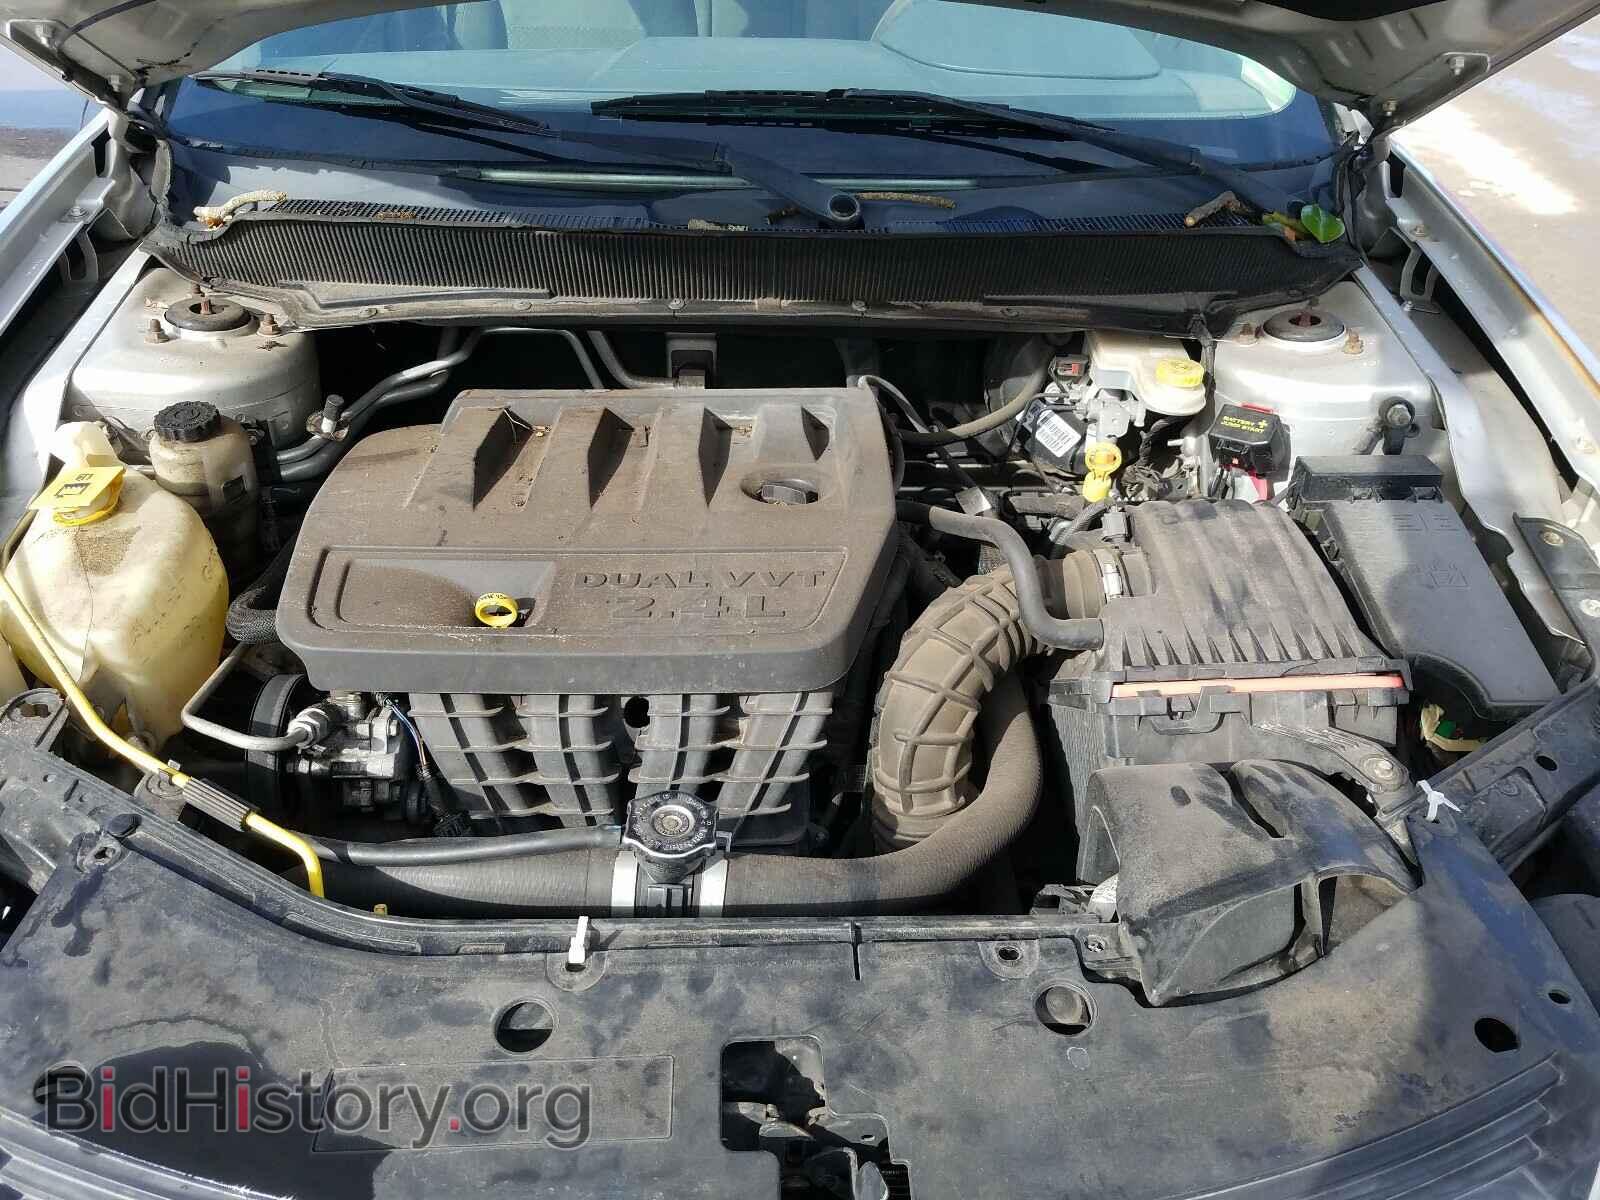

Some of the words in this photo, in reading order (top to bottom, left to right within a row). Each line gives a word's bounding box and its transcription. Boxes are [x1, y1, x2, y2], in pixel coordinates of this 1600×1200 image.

[1222, 416, 1255, 426] BATTERY
[1241, 425, 1264, 433] START
[575, 571, 711, 589] DUAL
[727, 571, 825, 588] VVT
[611, 596, 786, 619] 2.4L
